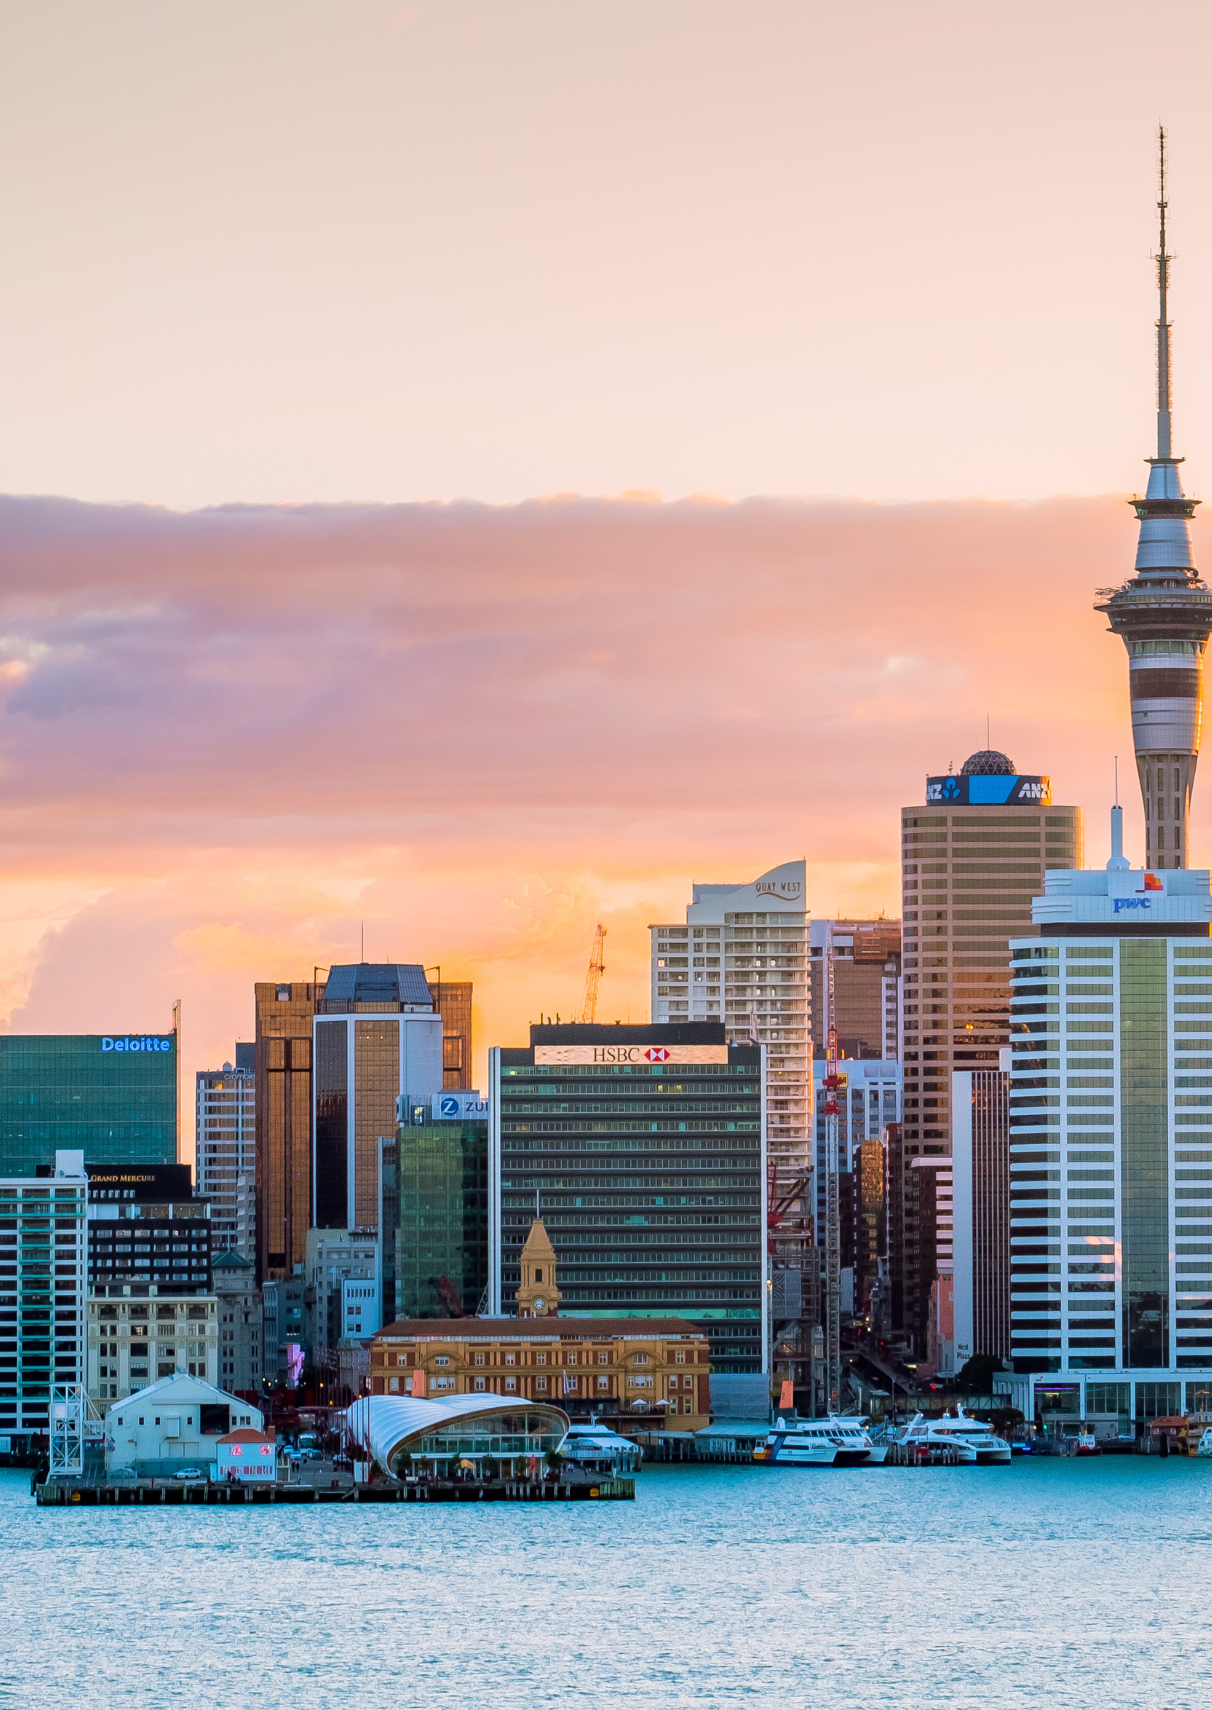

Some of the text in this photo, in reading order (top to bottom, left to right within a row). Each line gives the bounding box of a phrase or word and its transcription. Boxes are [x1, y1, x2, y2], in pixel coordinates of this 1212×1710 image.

[926, 784, 942, 800] NZ
[1018, 783, 1047, 798] ANZ
[755, 881, 801, 892] QUAY WEST
[1113, 897, 1151, 913] pwc
[102, 1037, 170, 1052] Deloitte
[593, 1047, 640, 1062] HSBC
[90, 1174, 156, 1182] GRAND MERCURE
